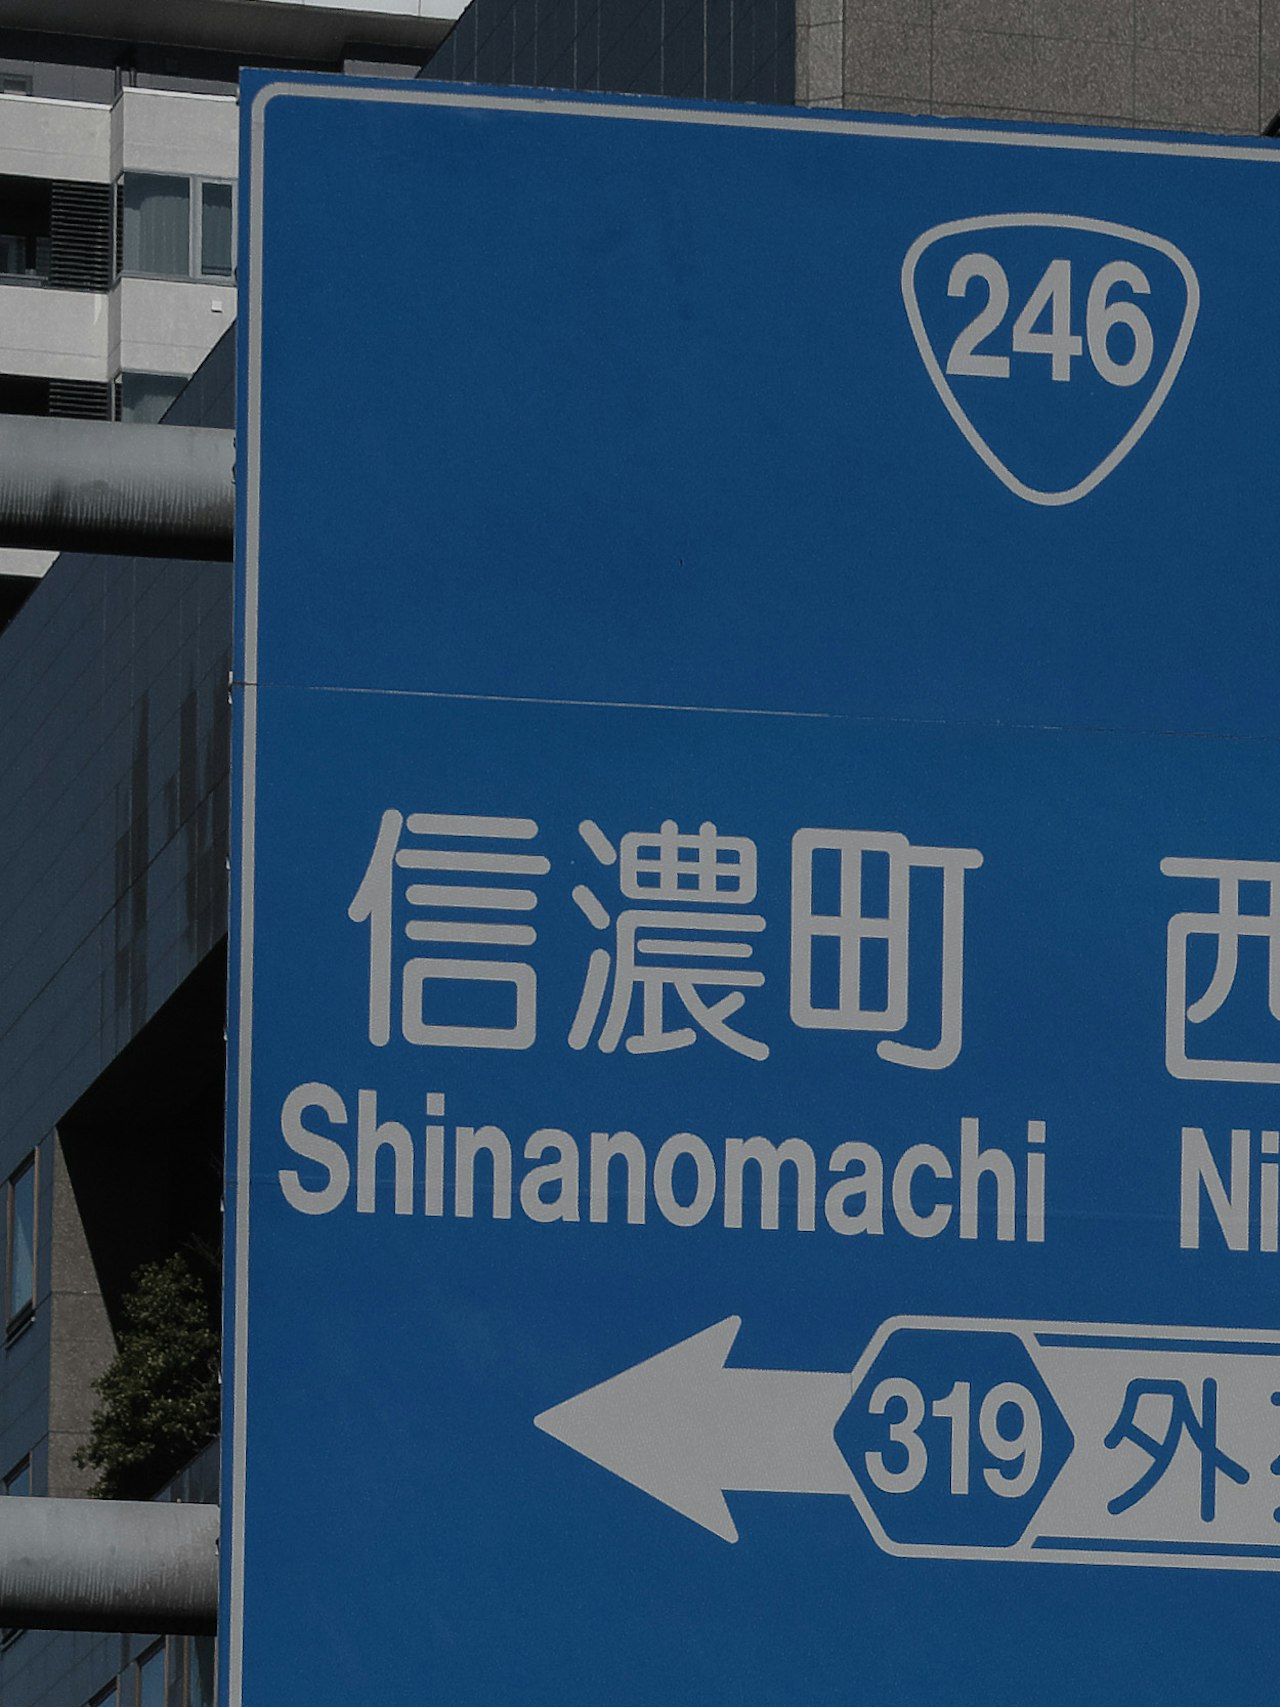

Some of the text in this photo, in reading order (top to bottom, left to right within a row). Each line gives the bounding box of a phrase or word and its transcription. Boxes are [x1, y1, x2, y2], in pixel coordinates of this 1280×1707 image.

[946, 253, 1154, 387] 246
[348, 809, 983, 1070] 信濃町
[279, 1082, 1046, 1242] Shinanomachi
[864, 1378, 1046, 1499] 319
